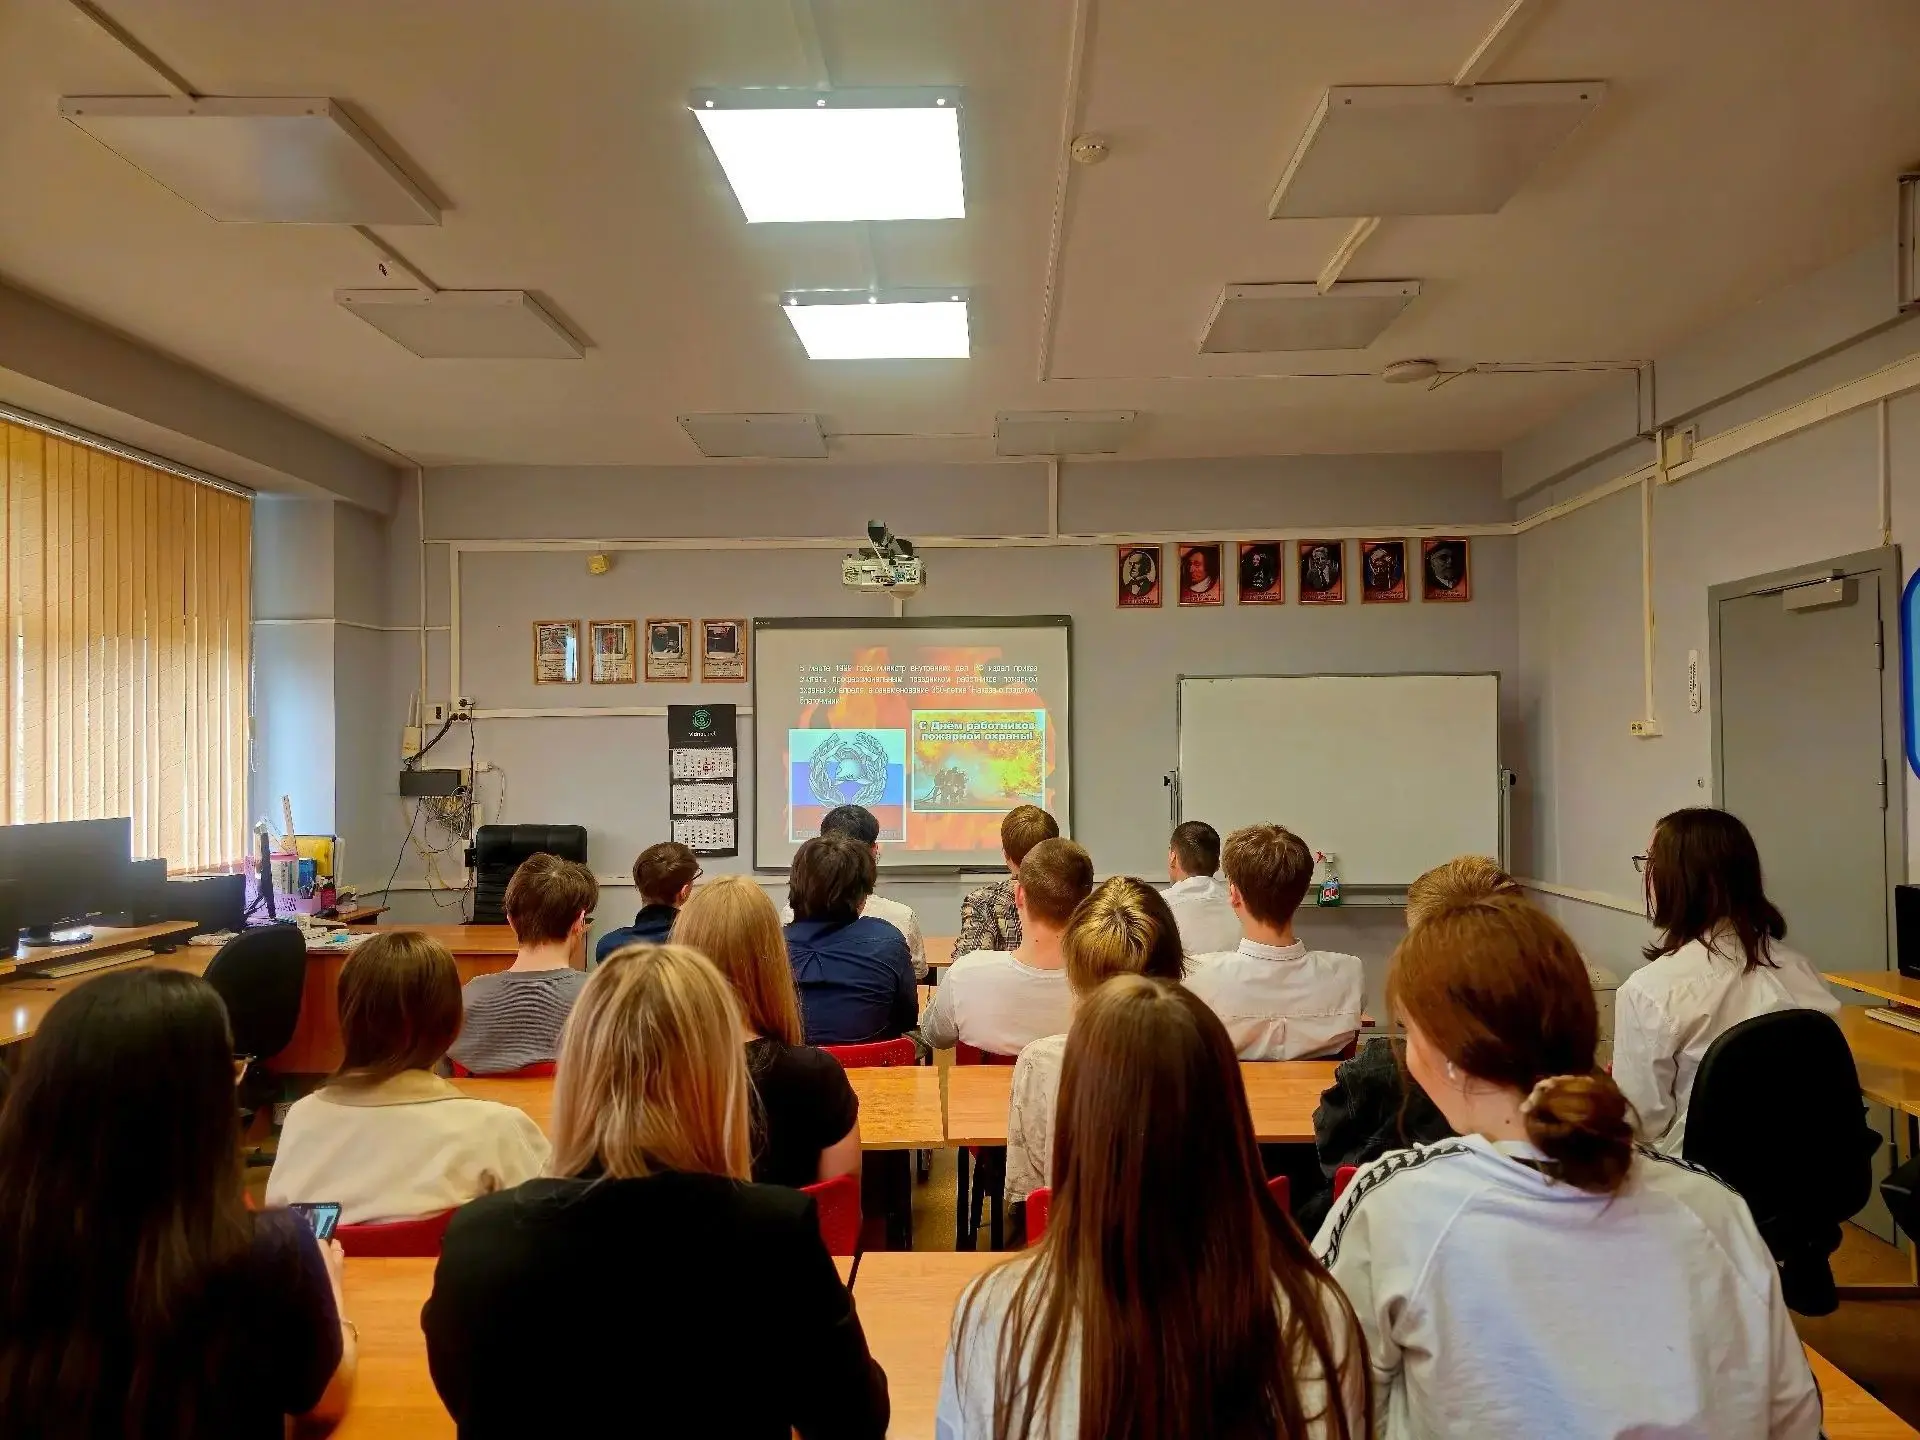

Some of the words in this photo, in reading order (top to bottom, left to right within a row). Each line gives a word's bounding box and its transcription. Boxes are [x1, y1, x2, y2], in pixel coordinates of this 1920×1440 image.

[956, 675, 996, 684] работников
[1004, 675, 1038, 684] пожарной
[919, 721, 927, 730] С
[930, 721, 963, 732] Днём
[966, 721, 1036, 731] работников
[921, 731, 980, 741] пожарной
[985, 732, 1033, 741] охраны!
